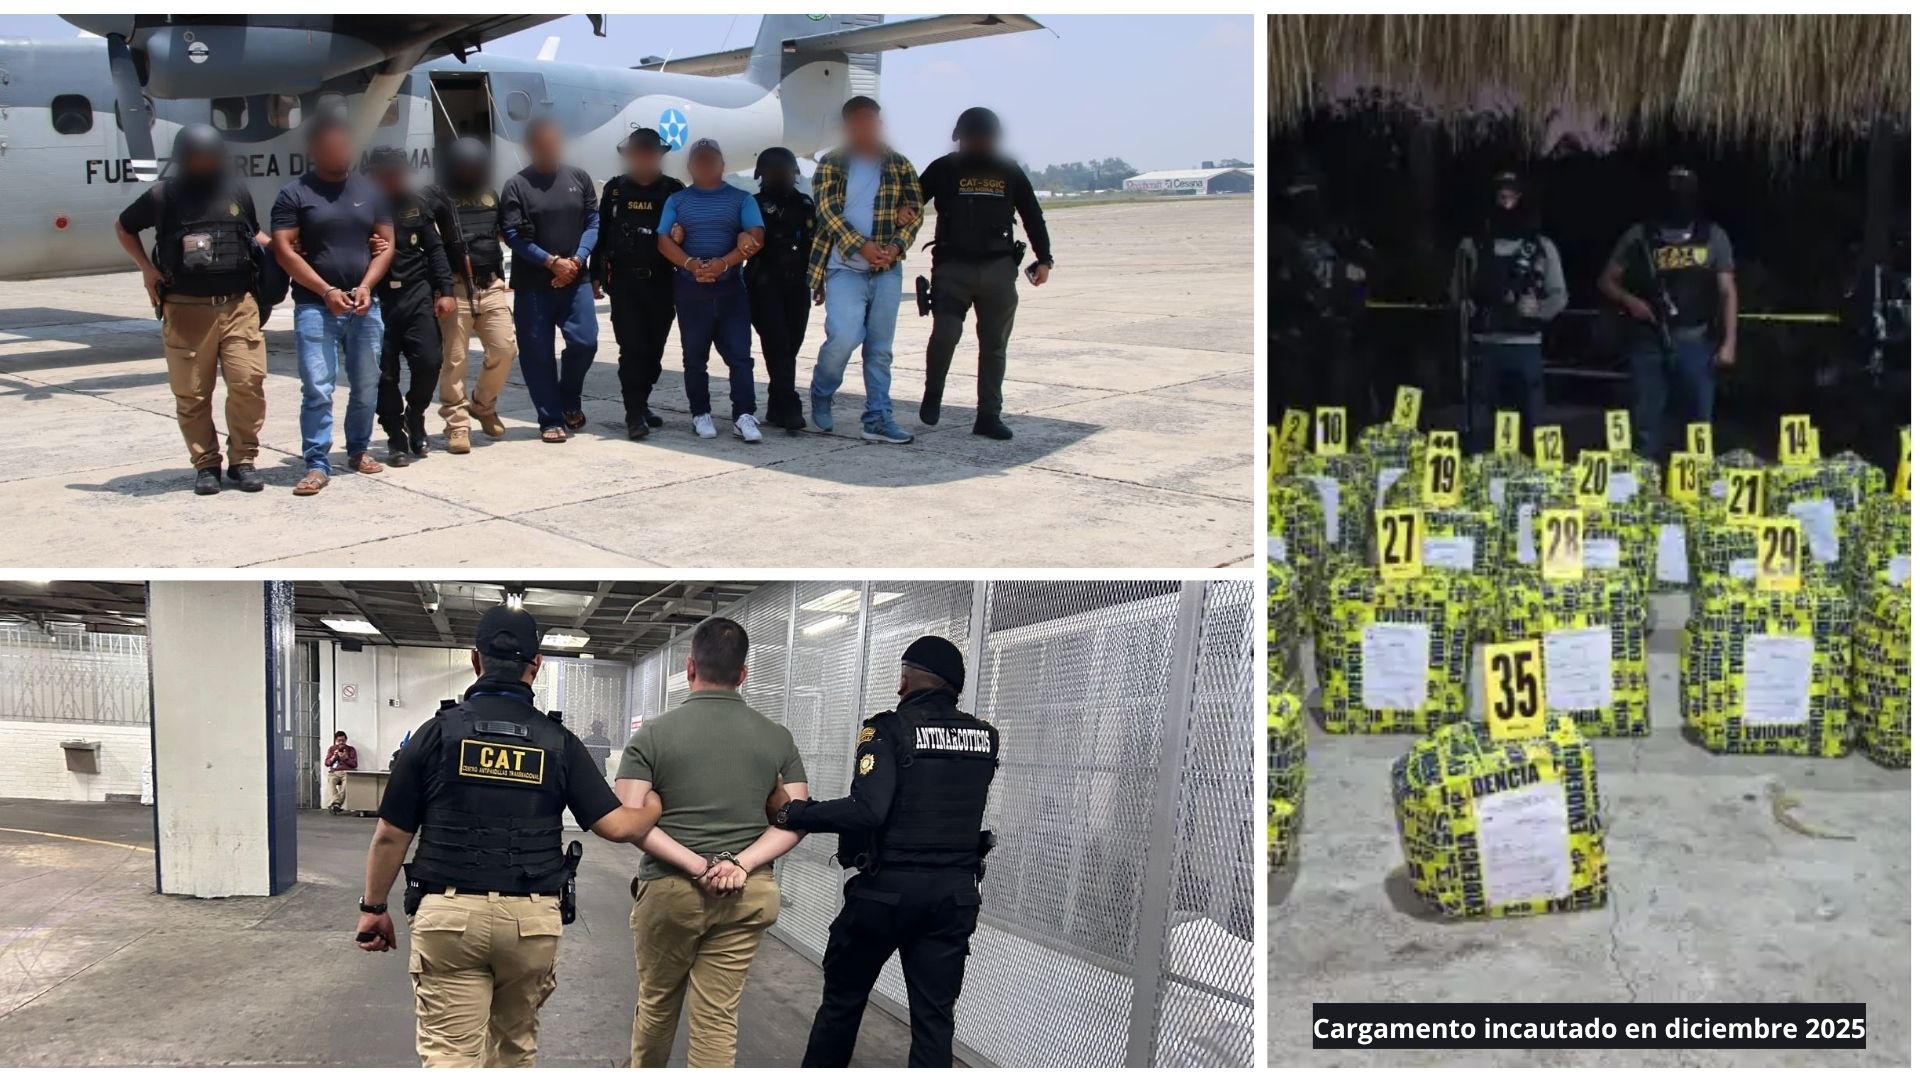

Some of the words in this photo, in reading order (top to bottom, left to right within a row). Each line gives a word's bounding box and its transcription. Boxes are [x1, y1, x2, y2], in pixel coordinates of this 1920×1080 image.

[86, 157, 180, 184] FUEZ
[1402, 394, 1414, 417] 3
[1287, 415, 1300, 441] 2
[1318, 412, 1342, 444] 10
[1502, 416, 1512, 444] 4
[1613, 415, 1623, 442] 5
[1694, 428, 1705, 454] 6
[1784, 421, 1807, 454] 14
[1538, 431, 1560, 460] 12
[1430, 455, 1456, 493] 19
[1581, 456, 1608, 495] 20
[1676, 460, 1696, 491] 13
[1729, 475, 1757, 516] 21
[1383, 515, 1415, 564] 27
[1549, 517, 1579, 562] 28
[1763, 526, 1798, 576] 29
[1491, 651, 1538, 720] 35
[915, 727, 991, 753] ANTINARCOTICOS
[480, 747, 526, 771] CAT
